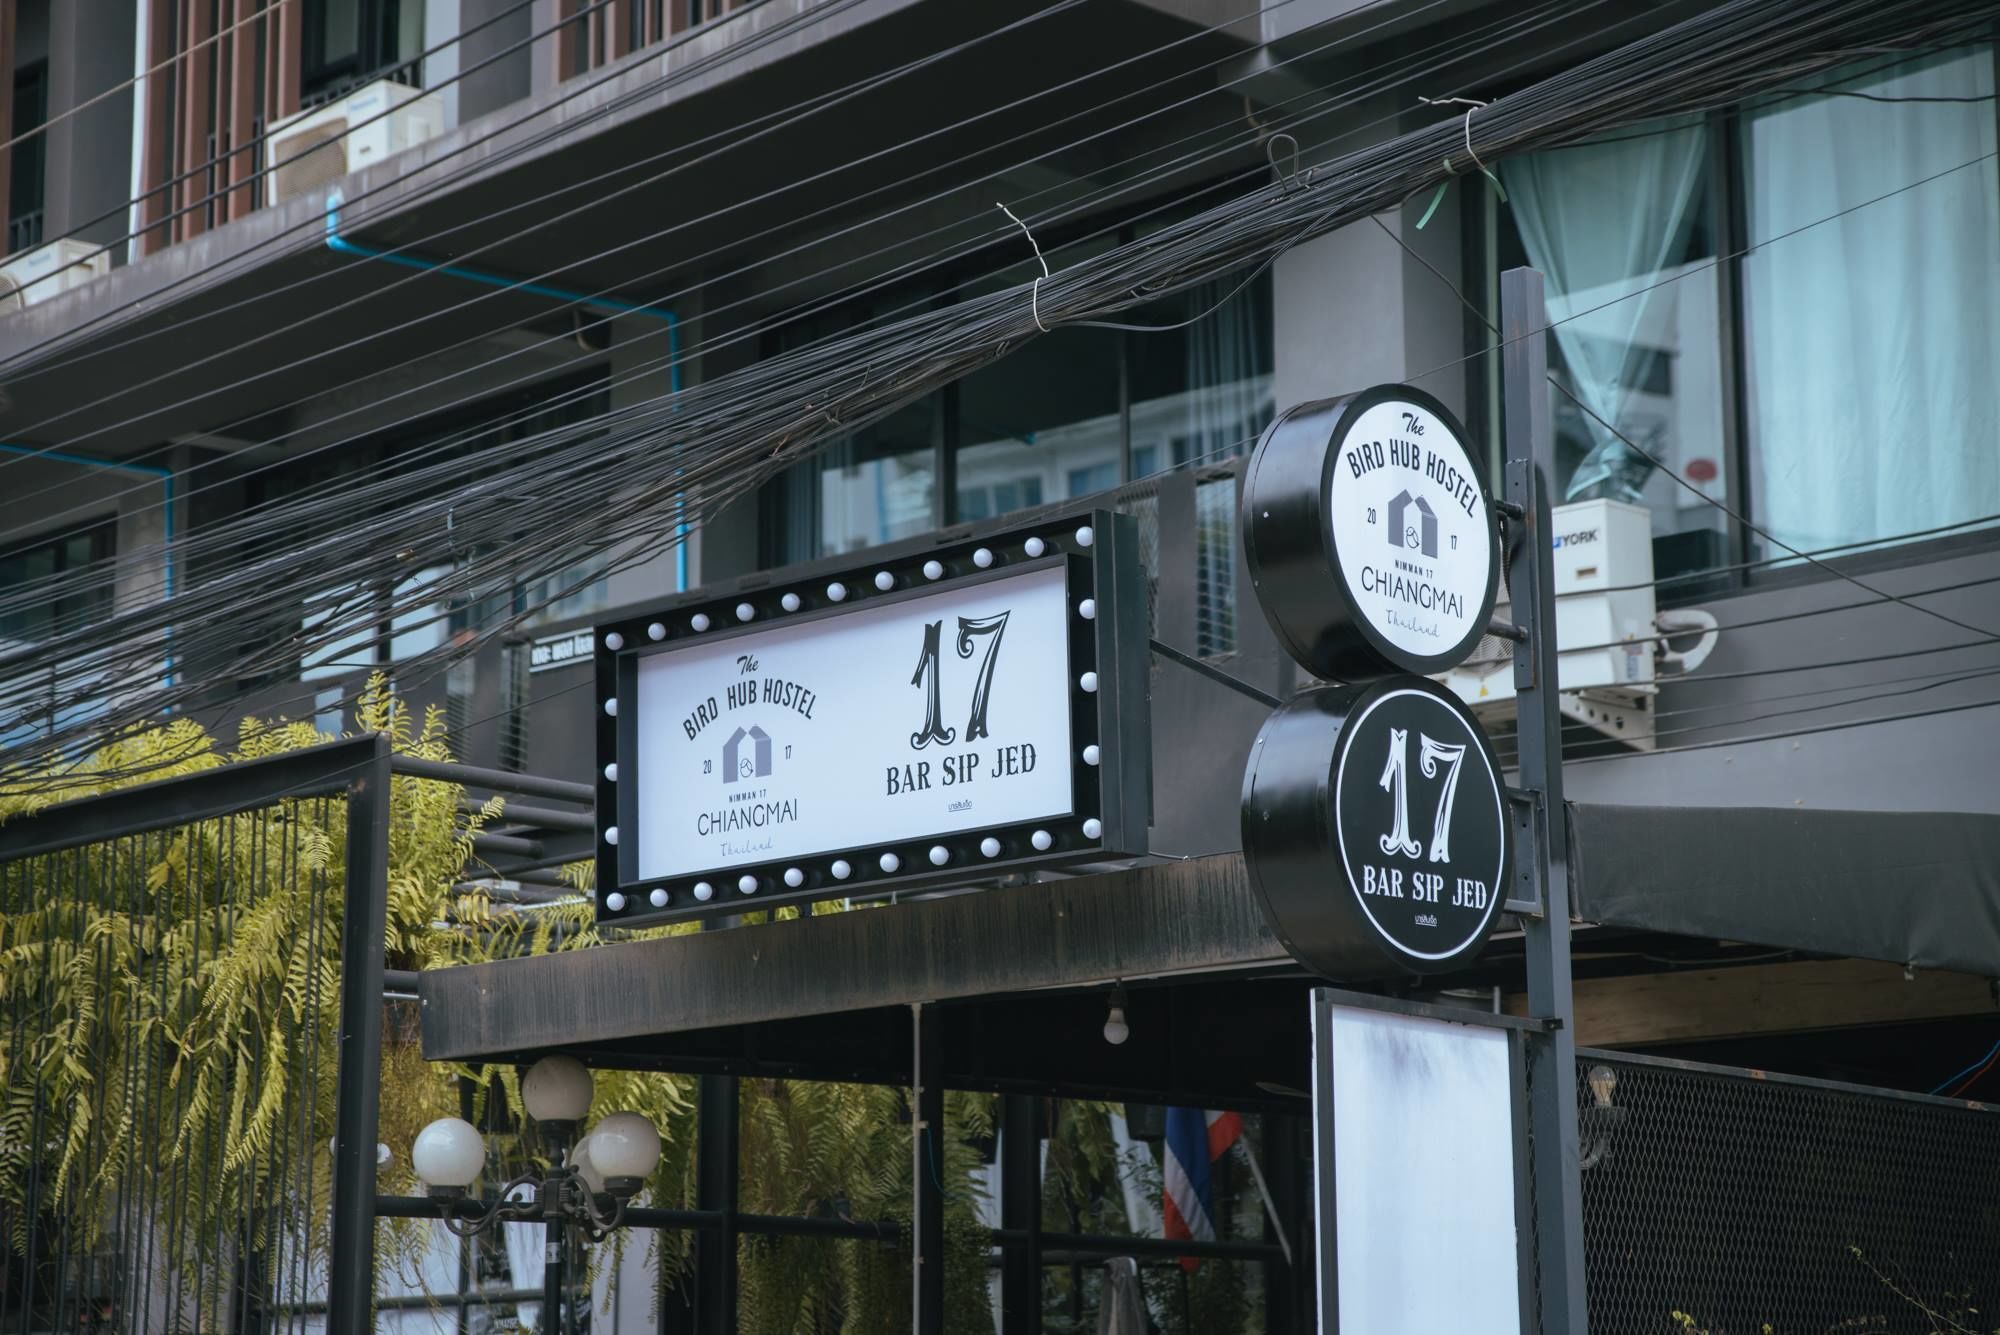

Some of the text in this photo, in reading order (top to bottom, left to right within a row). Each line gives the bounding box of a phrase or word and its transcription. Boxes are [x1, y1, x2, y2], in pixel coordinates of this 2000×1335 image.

[1402, 412, 1424, 436] The
[1346, 439, 1478, 519] BIRD HUB HOSTEL
[1367, 507, 1377, 525] 20
[1450, 534, 1457, 551] 17
[1562, 529, 1598, 547] YORK
[1395, 559, 1433, 579] NIMMAN 17
[1361, 566, 1463, 619] CHIANGMAI
[1385, 609, 1440, 638] Thailand
[736, 654, 760, 676] The
[910, 609, 1011, 750] 17
[683, 678, 816, 741] BIRD HUB HOSTEL
[785, 745, 792, 760] 17
[703, 759, 712, 775] 20
[886, 743, 1037, 796] BAR SIP JED
[729, 789, 767, 803] NIMMAN 17
[1379, 727, 1467, 864] 17
[697, 798, 798, 836] CHIANGMAI
[720, 837, 773, 857] Thailand
[1363, 864, 1487, 910] BAR SIP JED
